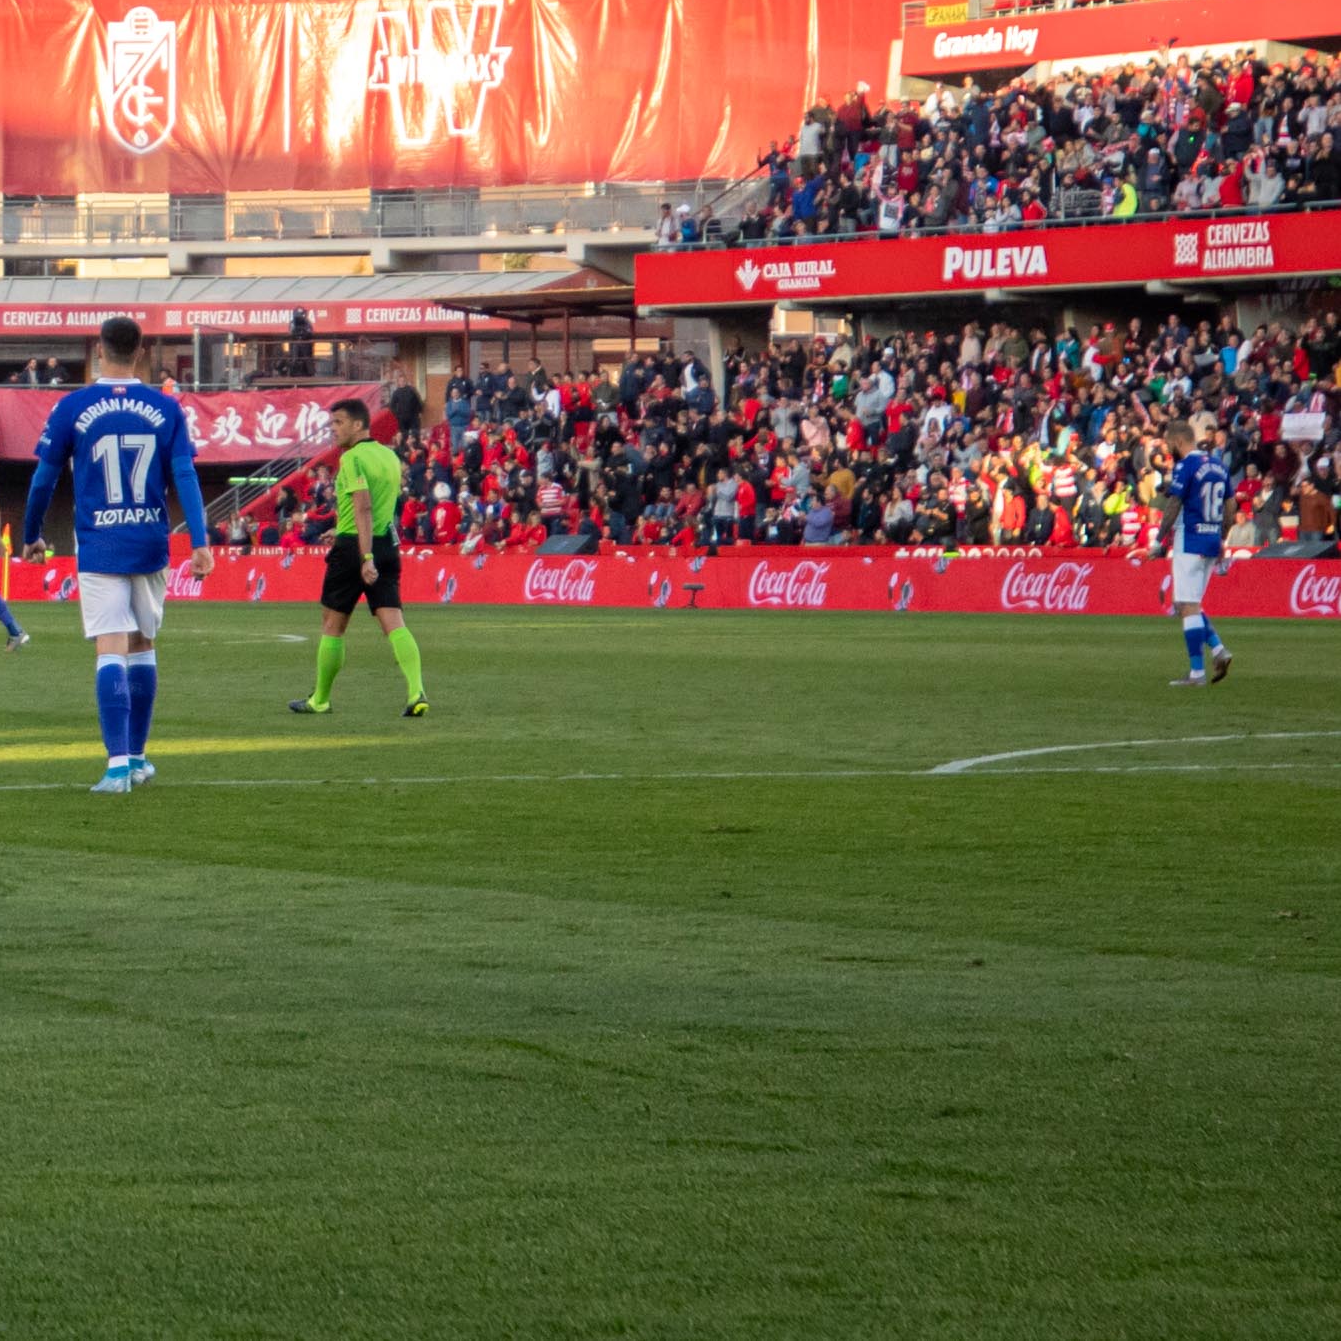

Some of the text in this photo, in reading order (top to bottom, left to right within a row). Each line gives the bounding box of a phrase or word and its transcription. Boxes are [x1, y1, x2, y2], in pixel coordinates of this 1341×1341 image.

[934, 25, 1038, 58] Granada Hoy
[1208, 221, 1270, 246] CERVEZAS
[763, 260, 836, 278] CAJA RURAL
[943, 245, 1048, 280] PULEVA
[1203, 245, 1274, 269] ALHAMBRA
[778, 277, 820, 289] GRANADA
[3, 311, 63, 326] CERVEZAS
[187, 310, 244, 325] CERVEZAS
[366, 307, 421, 323] CERVEZAS
[75, 398, 166, 433] ADRIÁN MARÍN
[92, 434, 156, 504] 17
[525, 559, 598, 601] Coca-Cola
[748, 560, 832, 606] Coca-Cola
[1001, 561, 1093, 609] Coca-Cola
